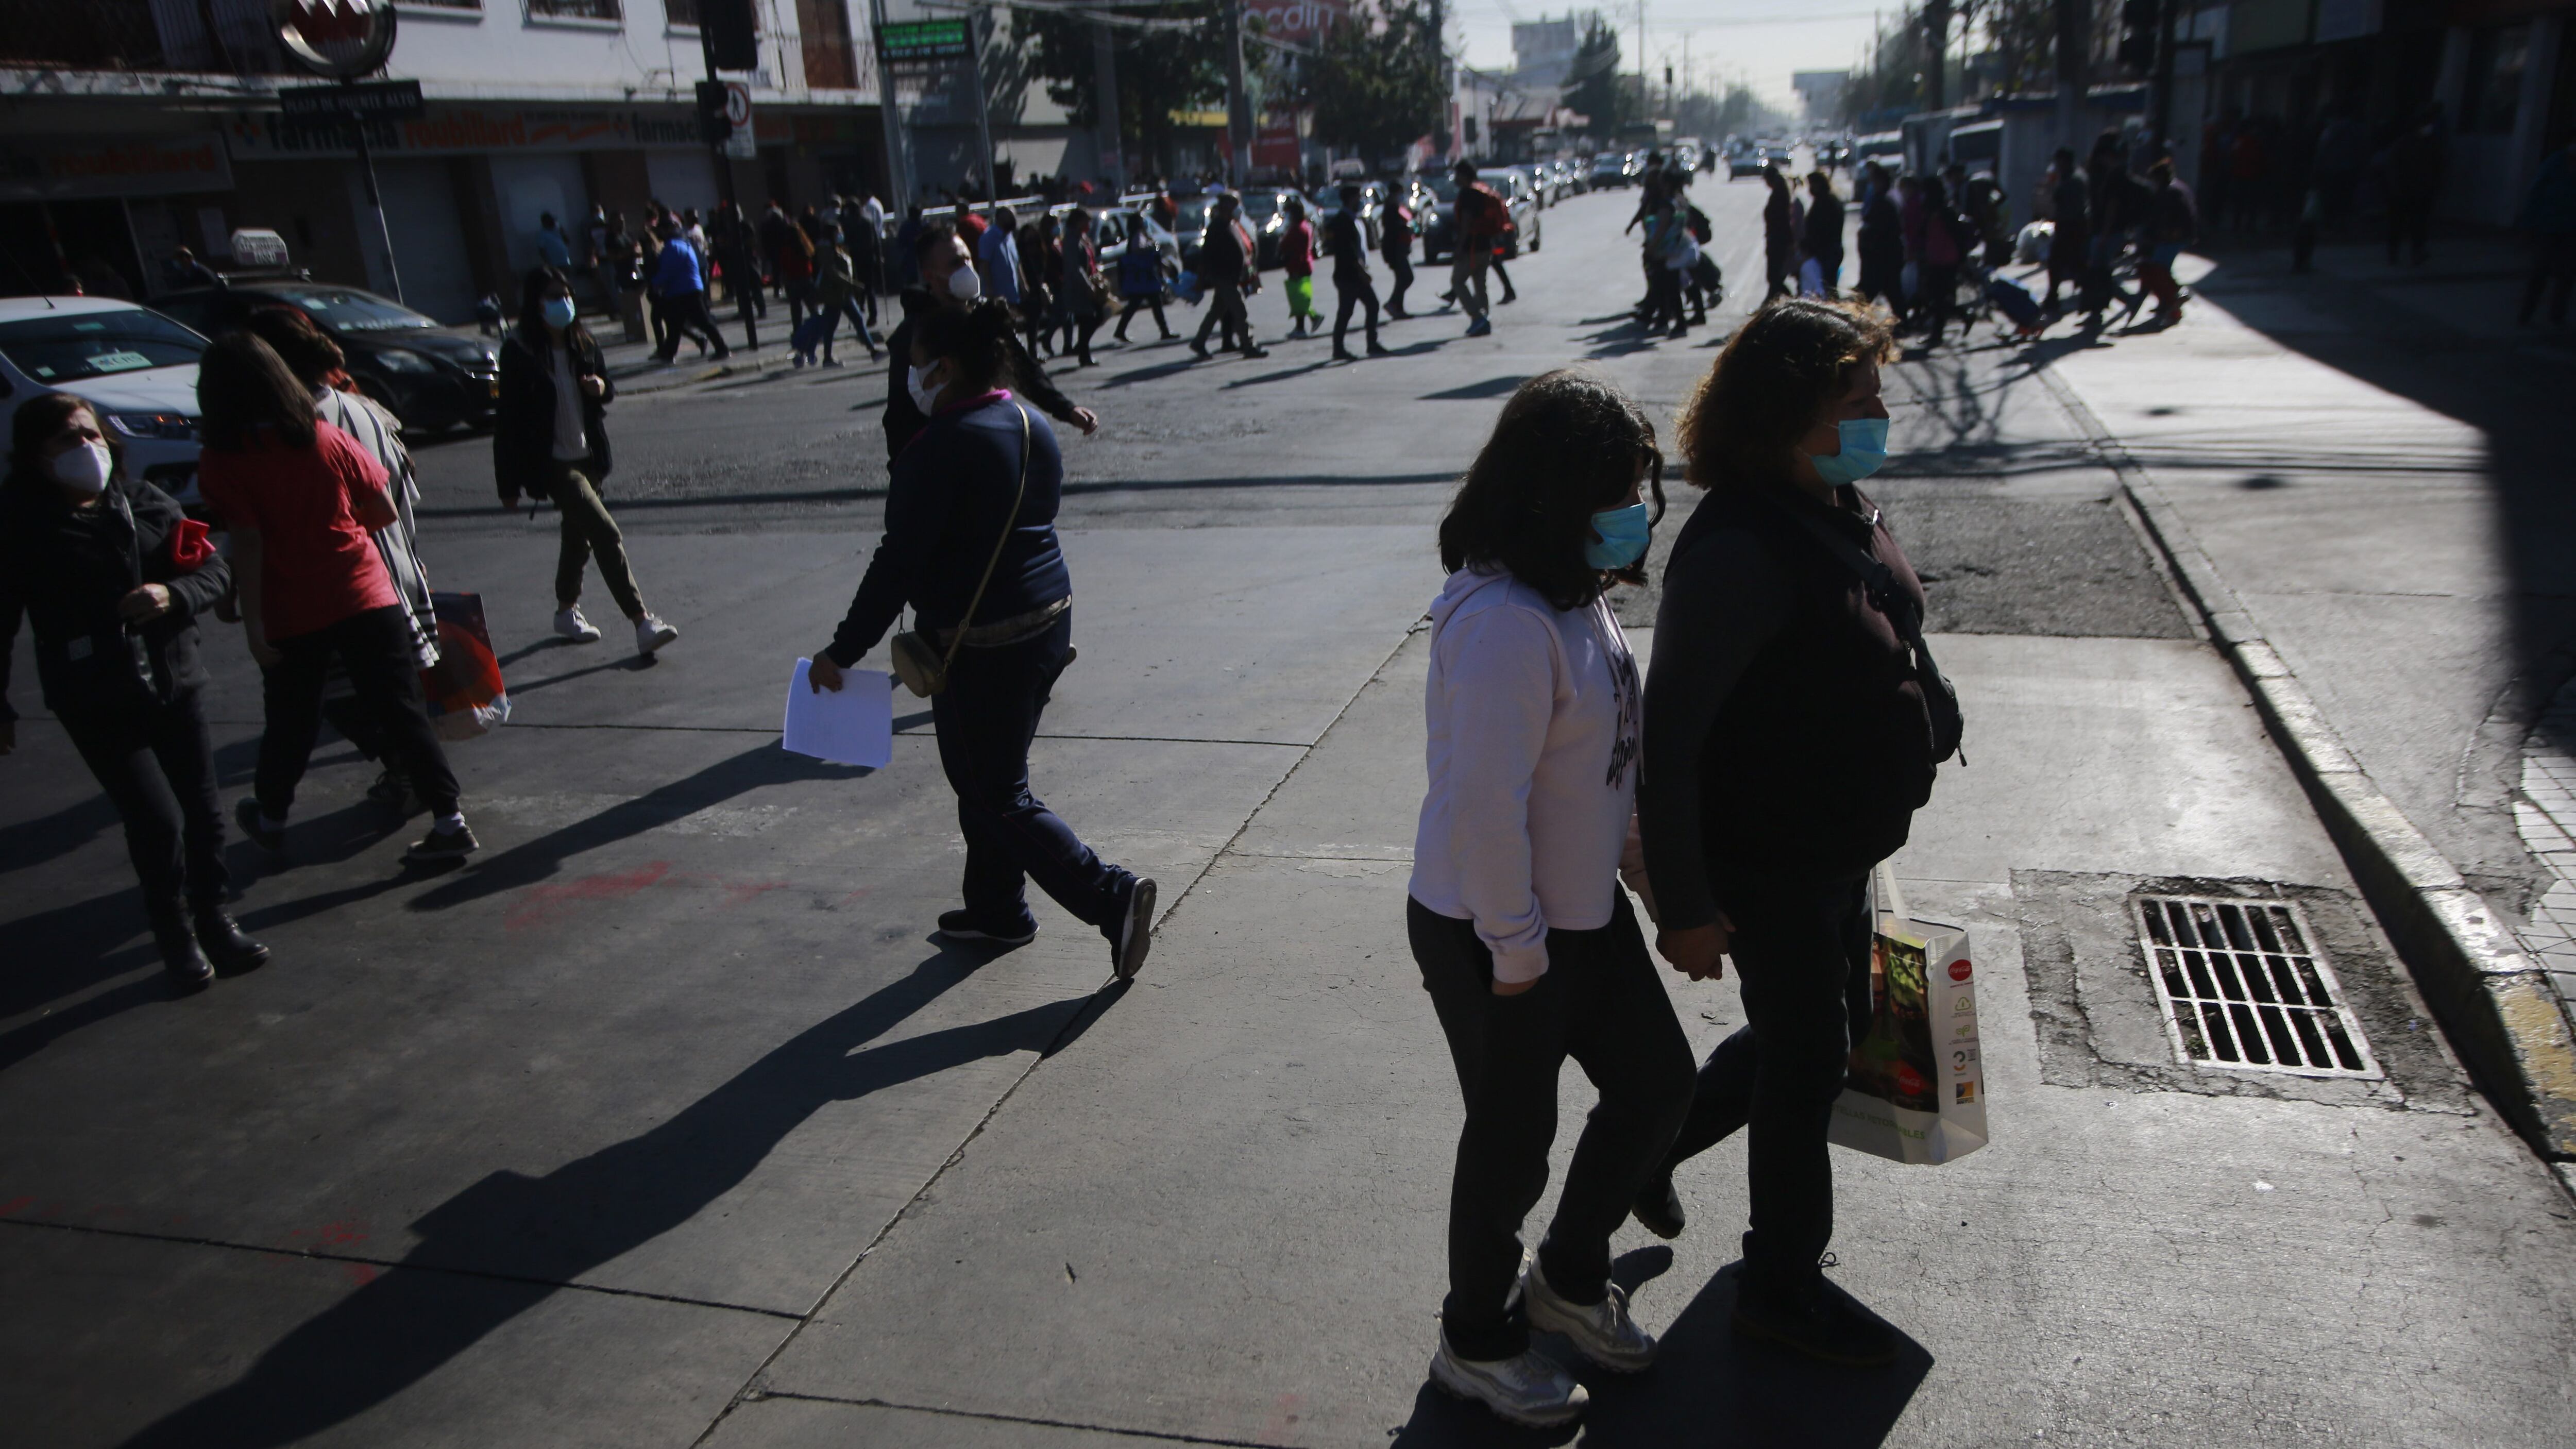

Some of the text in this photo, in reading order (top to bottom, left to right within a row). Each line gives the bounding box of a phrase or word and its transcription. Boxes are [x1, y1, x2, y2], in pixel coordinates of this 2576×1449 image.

[405, 109, 526, 148] roubillard
[631, 110, 703, 143] farmaci
[1832, 1104, 1866, 1120] TELLAS
